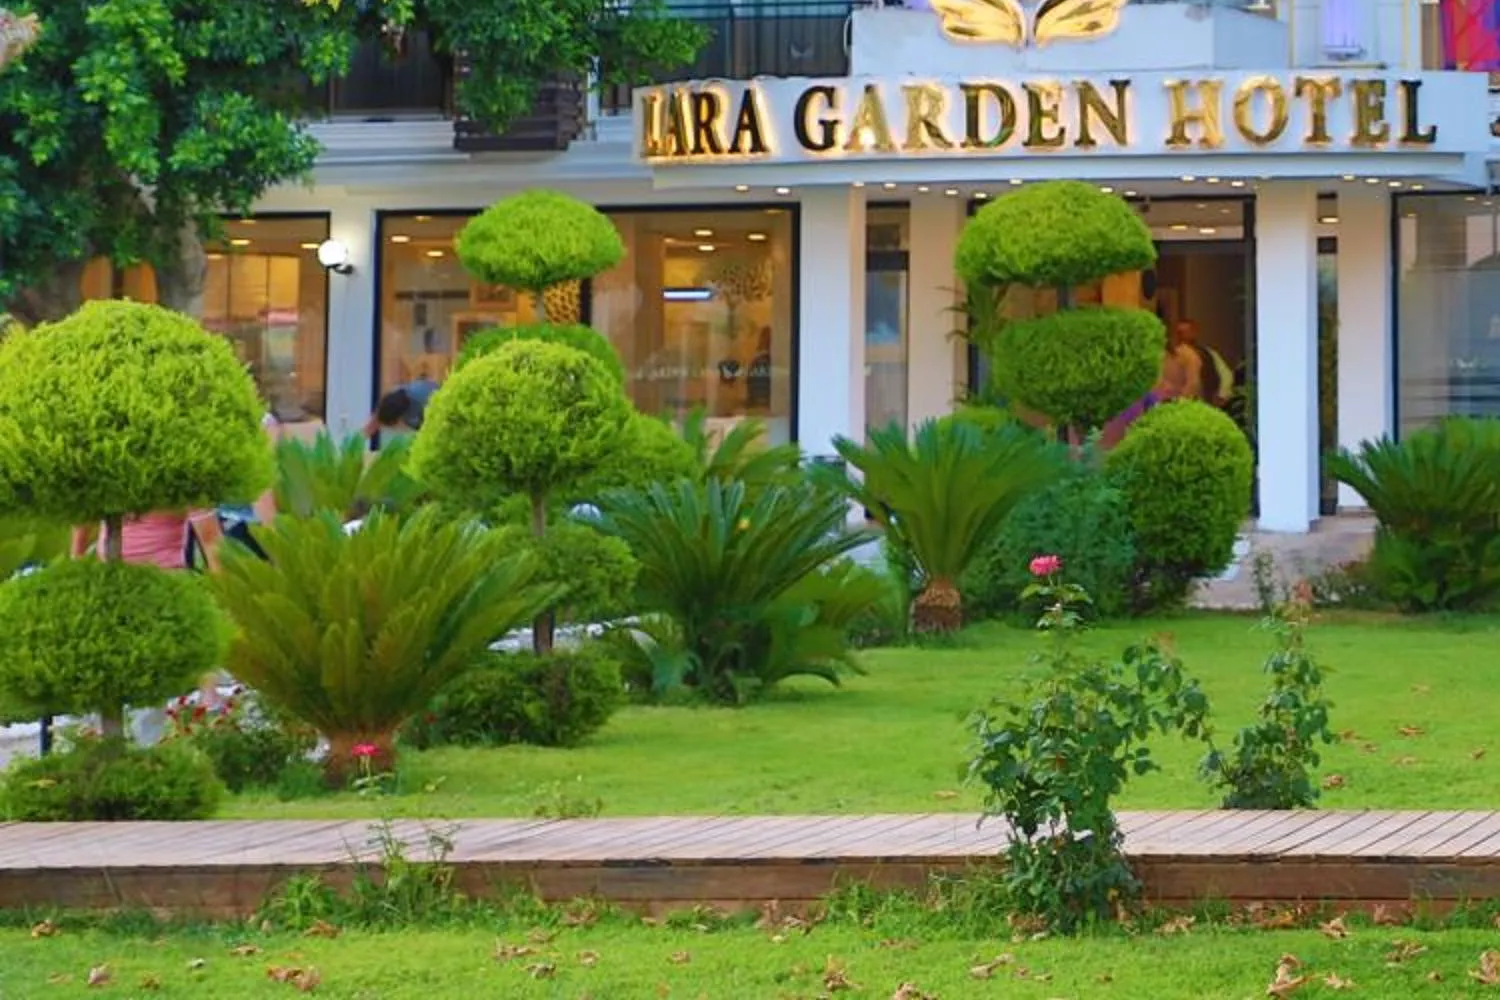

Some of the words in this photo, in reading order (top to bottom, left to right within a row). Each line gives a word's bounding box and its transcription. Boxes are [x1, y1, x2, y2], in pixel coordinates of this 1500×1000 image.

[642, 87, 770, 158] LARA
[793, 80, 1130, 151] GARDEN
[1164, 76, 1438, 147] HOTEL
